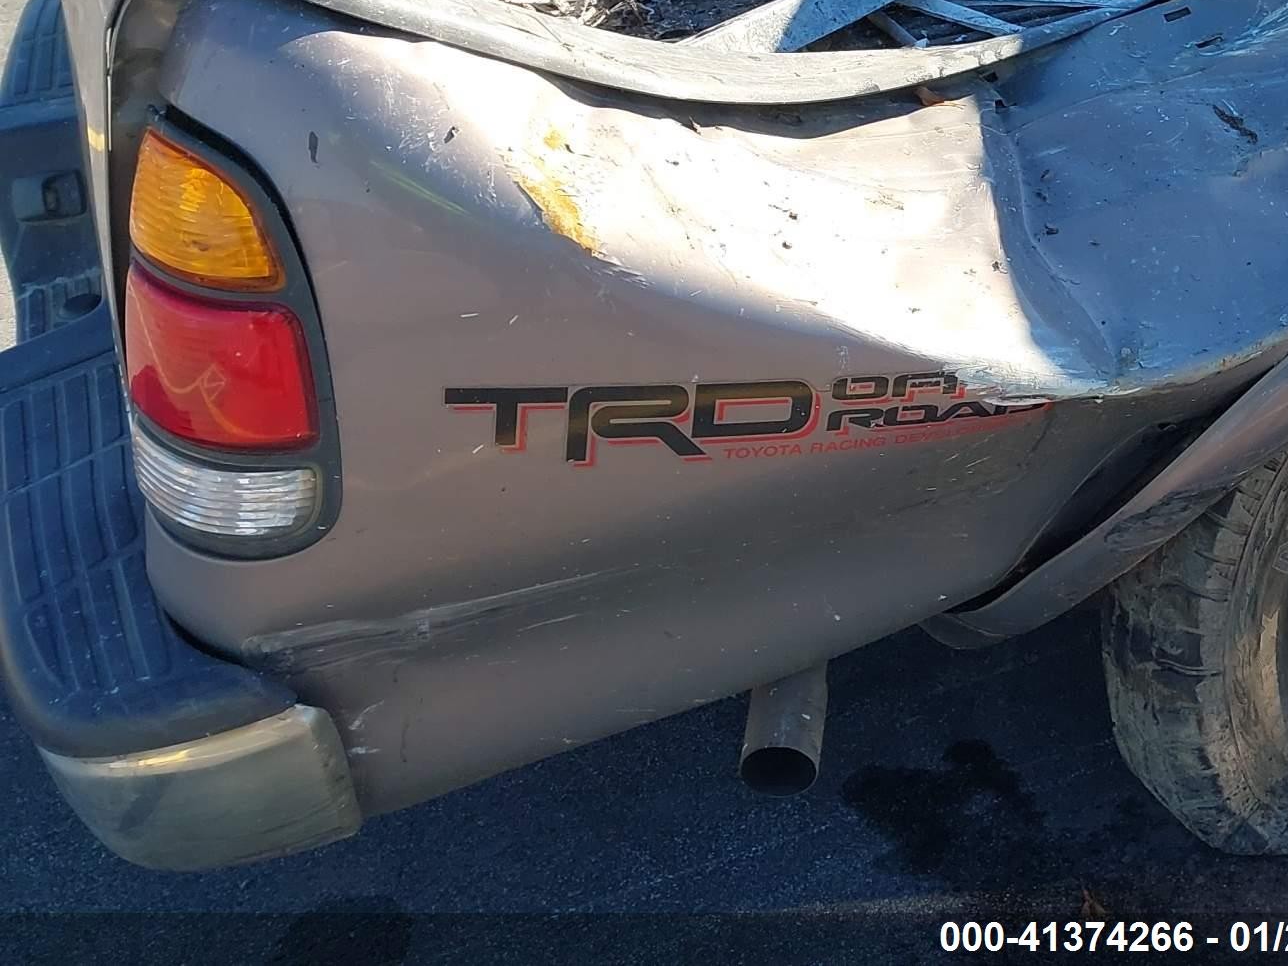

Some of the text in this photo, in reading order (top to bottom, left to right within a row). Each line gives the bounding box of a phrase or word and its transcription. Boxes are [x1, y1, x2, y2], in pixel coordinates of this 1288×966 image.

[444, 380, 818, 465] TRD
[723, 436, 887, 459] TOYOTA RACING
